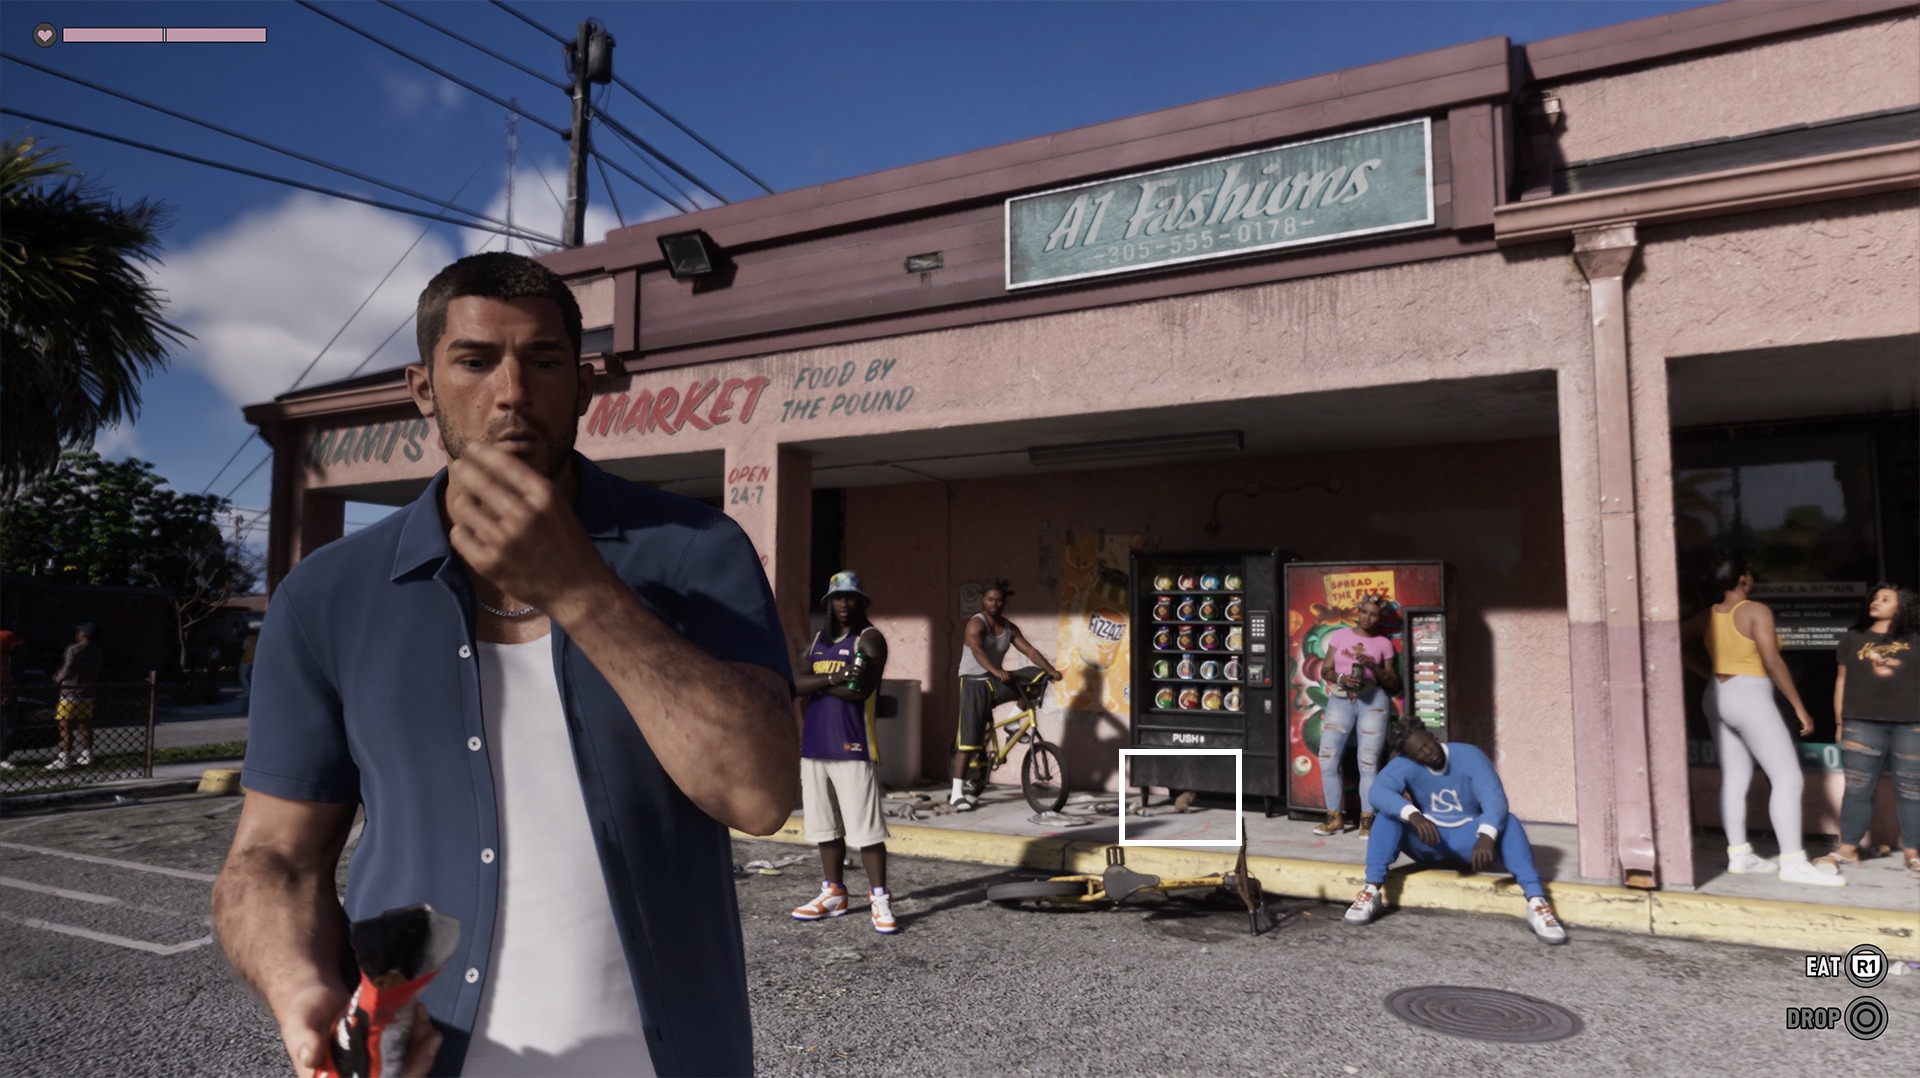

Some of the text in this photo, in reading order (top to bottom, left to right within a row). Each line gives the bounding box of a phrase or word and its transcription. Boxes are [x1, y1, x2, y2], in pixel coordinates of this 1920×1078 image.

[1043, 158, 1382, 252] A1 Fashions
[793, 358, 897, 390] FOOD BY
[586, 376, 771, 437] MARKET
[781, 386, 915, 423] THE POUND
[304, 418, 430, 467] MAMI'S
[728, 466, 771, 484] OPEN
[1331, 578, 1372, 589] SPREAD
[1331, 587, 1390, 601] THE FIZZ
[1754, 585, 1794, 593] ERVICE
[1811, 584, 1855, 593] REPAIR
[1172, 733, 1199, 743] PUSH
